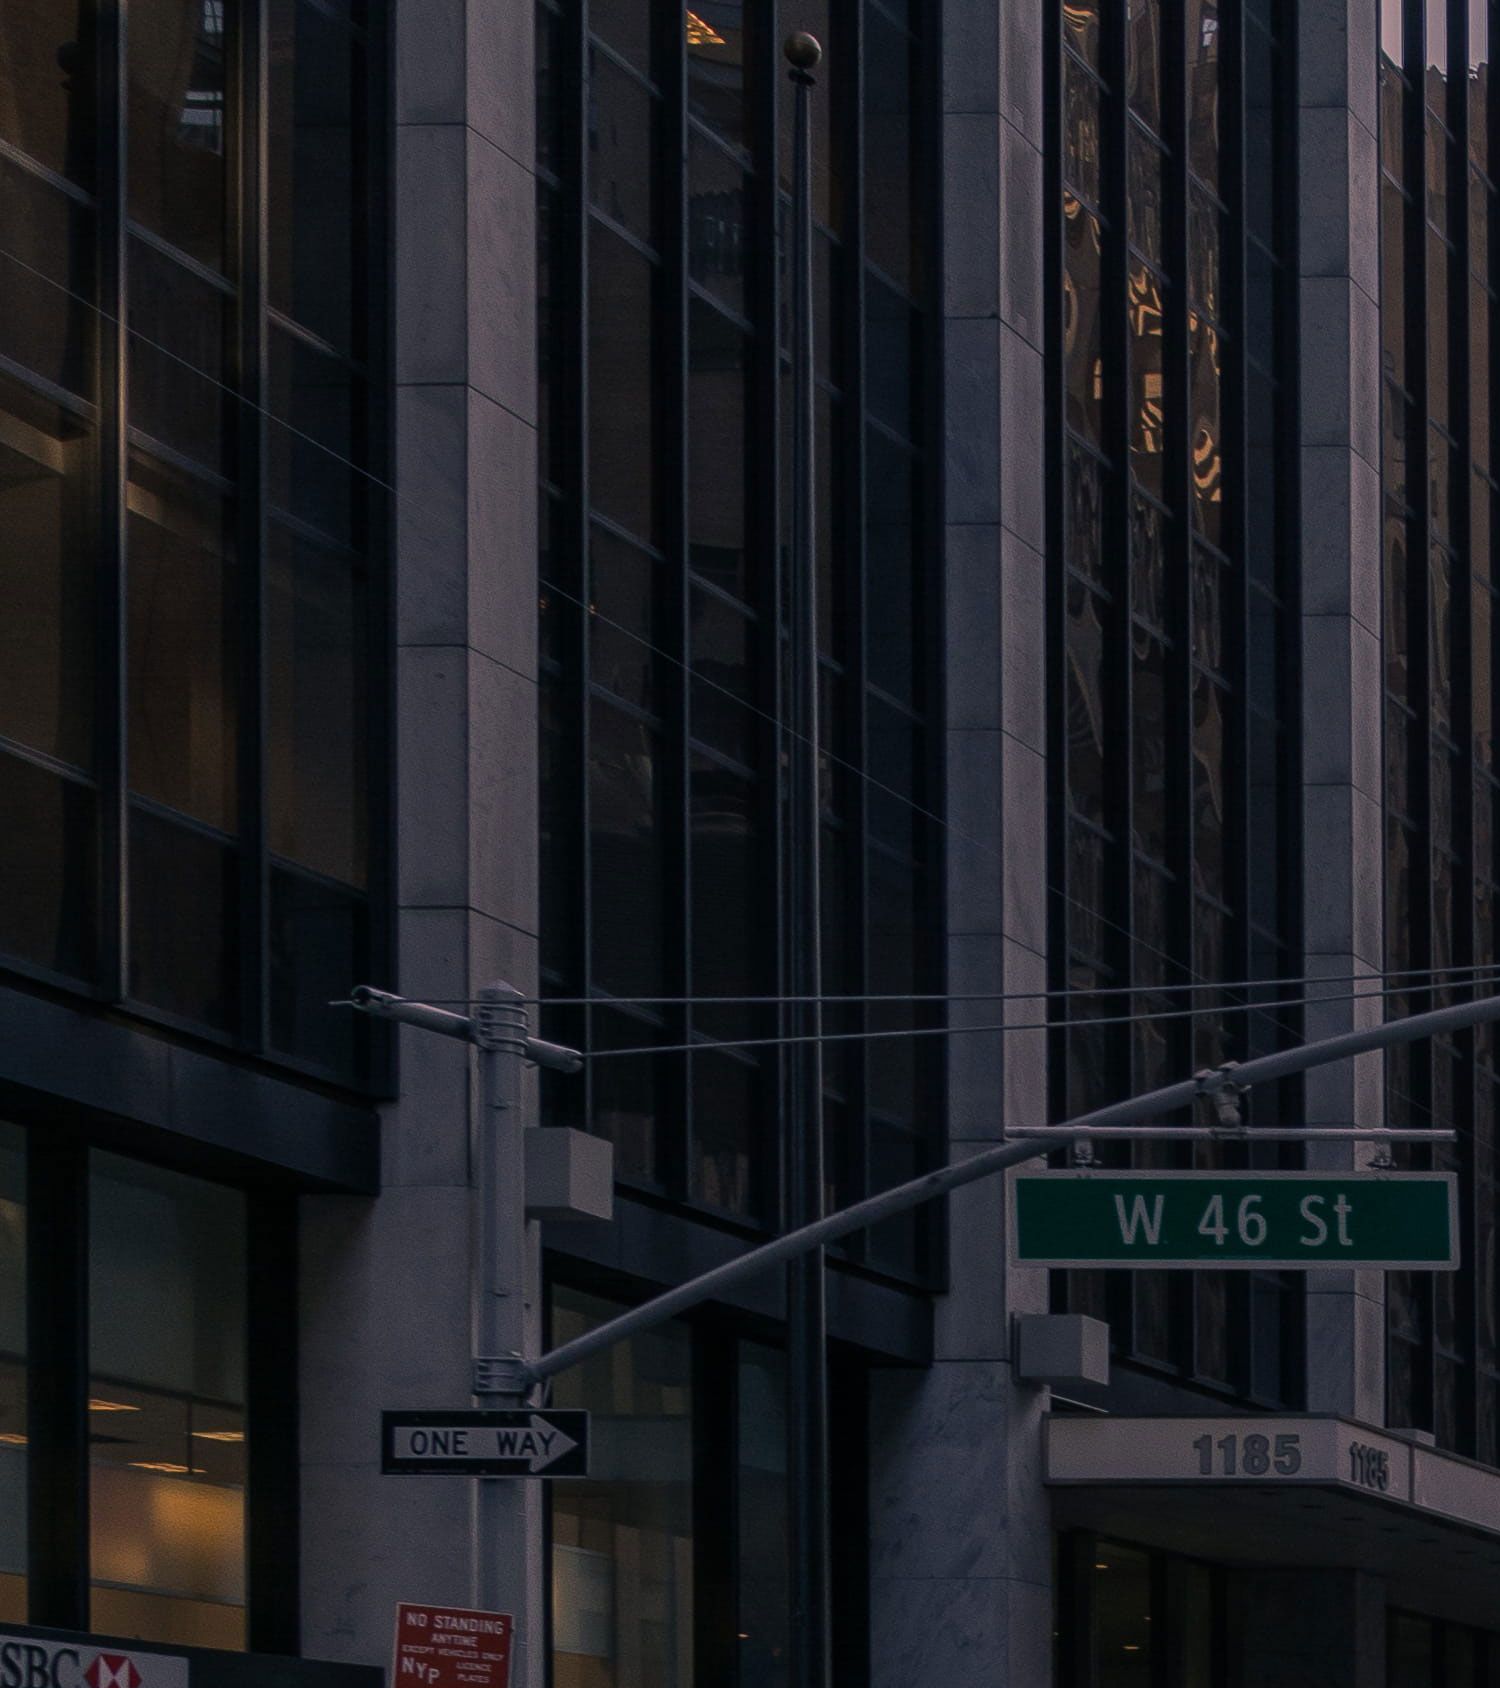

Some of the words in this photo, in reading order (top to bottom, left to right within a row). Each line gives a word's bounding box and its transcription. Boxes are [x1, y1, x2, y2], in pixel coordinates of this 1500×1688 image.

[1114, 1193, 1166, 1246] W
[1197, 1193, 1268, 1247] 46
[1298, 1193, 1355, 1247] St
[410, 1430, 468, 1455] ONE
[495, 1430, 557, 1456] WAY
[1192, 1433, 1301, 1475] 1185
[1348, 1440, 1389, 1492] 1185
[406, 1611, 427, 1628] NO
[433, 1614, 504, 1636] STANDING
[431, 1632, 479, 1648] ANYTIME
[401, 1656, 441, 1685] NYP
